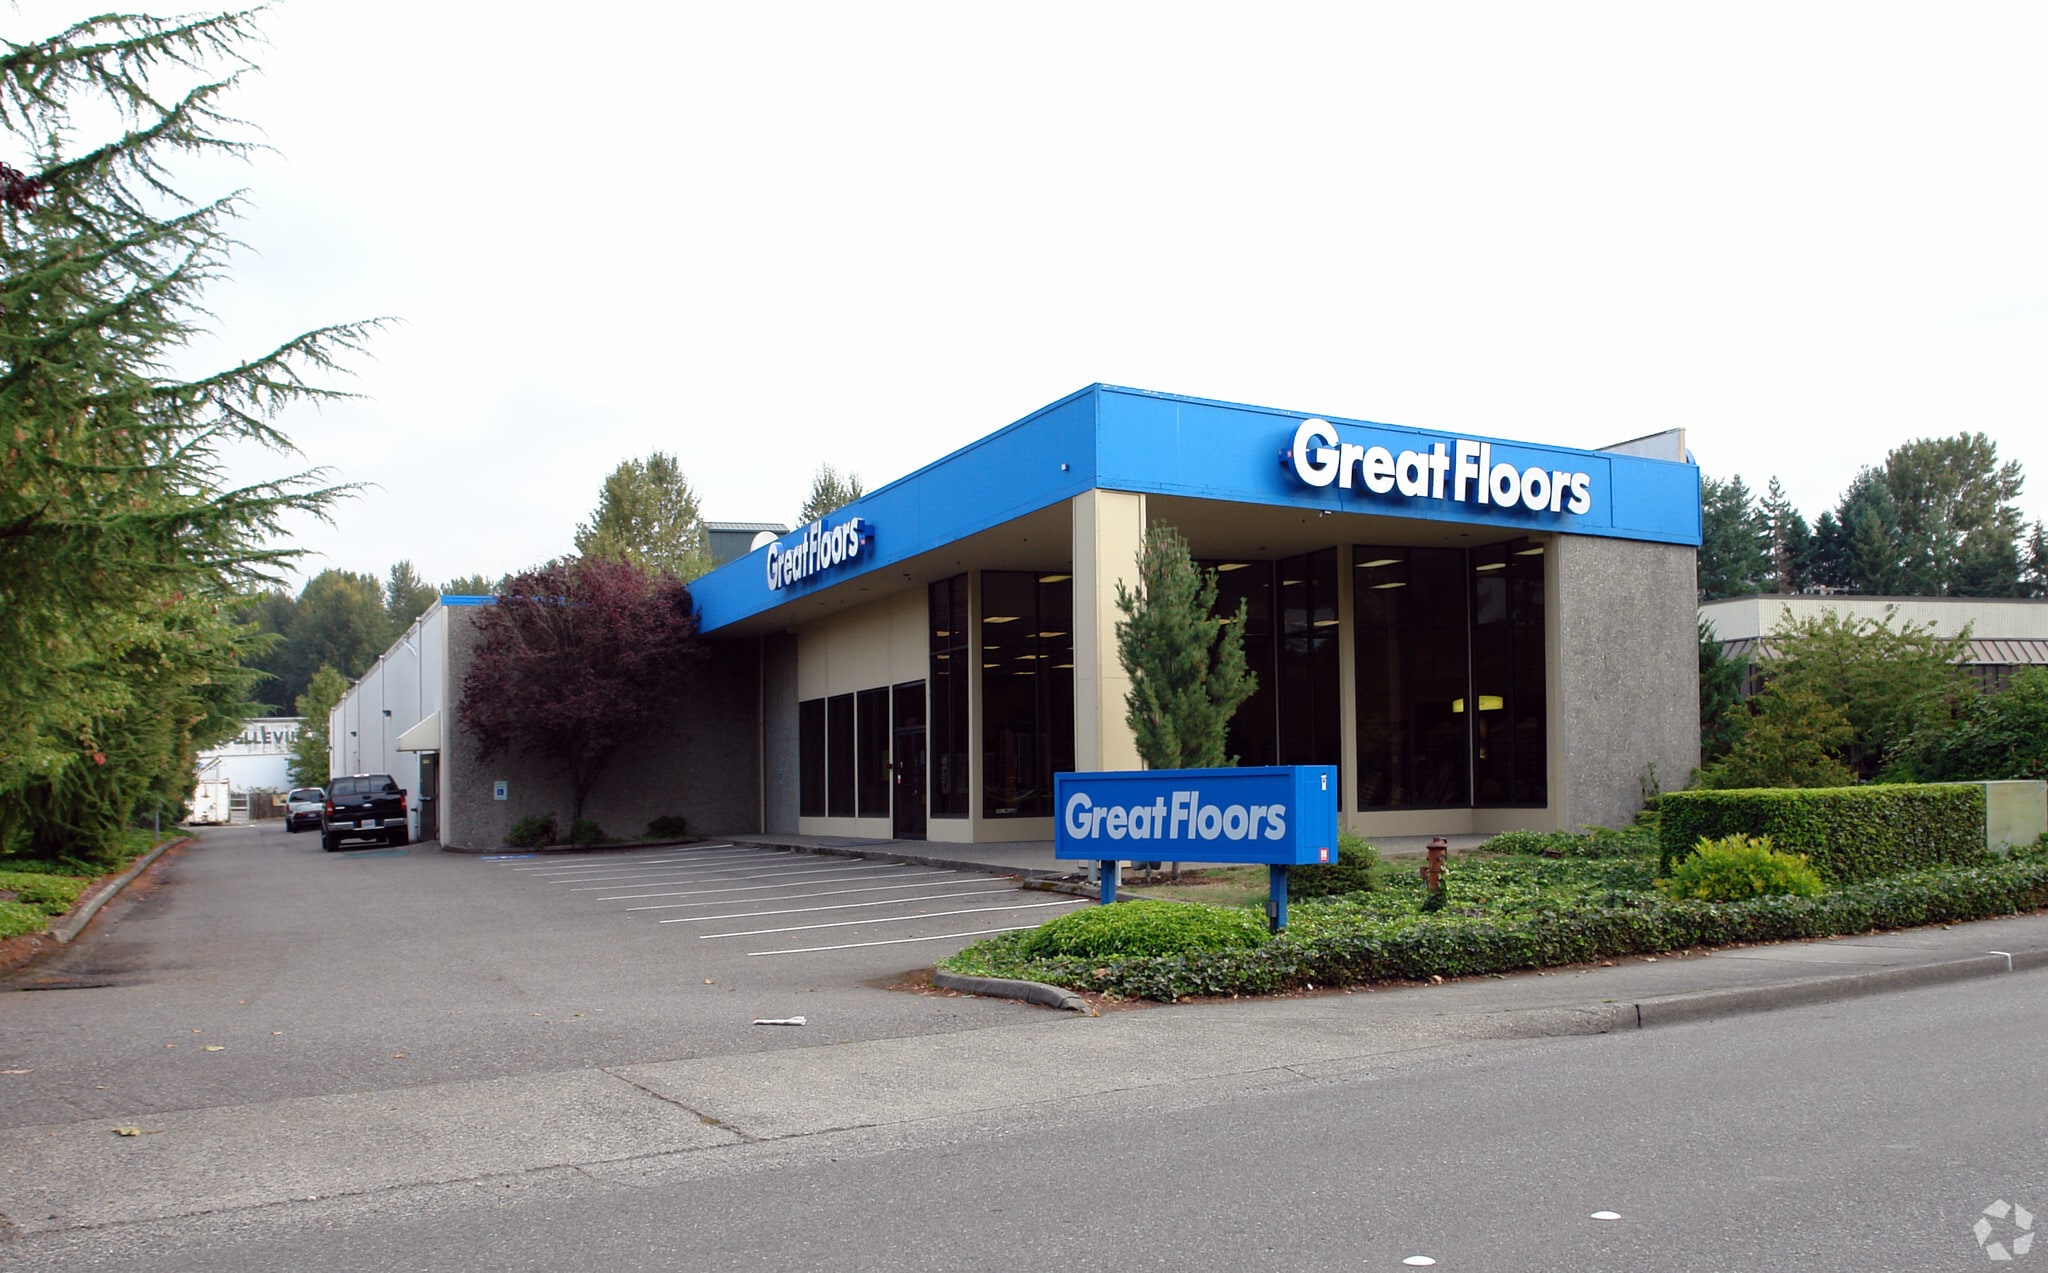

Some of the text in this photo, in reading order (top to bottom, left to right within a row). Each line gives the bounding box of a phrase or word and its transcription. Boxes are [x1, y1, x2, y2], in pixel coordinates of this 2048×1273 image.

[1293, 418, 1591, 515] Great Floors
[767, 517, 861, 591] Great Floors
[1065, 791, 1286, 841] Great Floors
